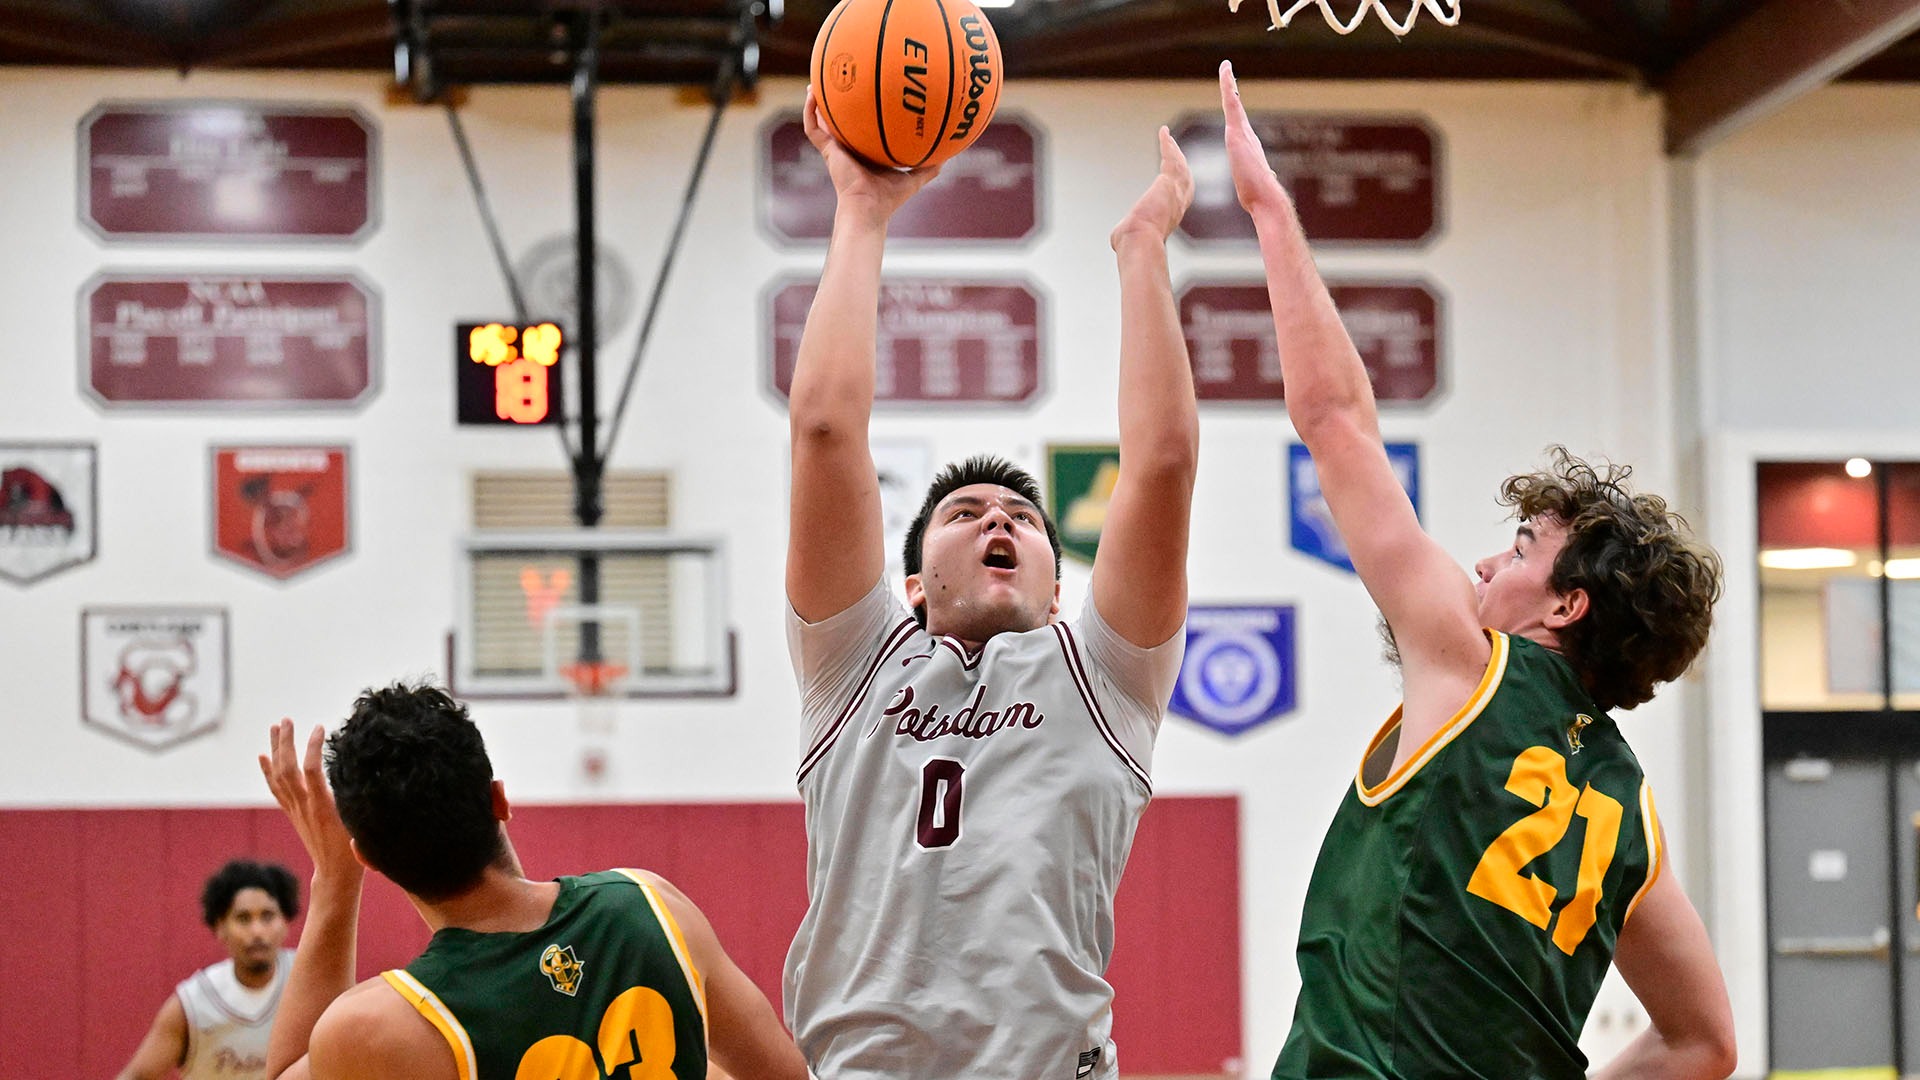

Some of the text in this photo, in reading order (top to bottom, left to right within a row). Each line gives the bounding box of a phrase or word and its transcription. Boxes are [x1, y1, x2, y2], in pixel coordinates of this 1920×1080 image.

[903, 37, 928, 115] EVO
[950, 13, 992, 140] Wilson
[496, 359, 548, 423] 18
[867, 685, 1044, 742] Potsdam
[914, 756, 966, 852] 0
[1466, 745, 1624, 957] 21
